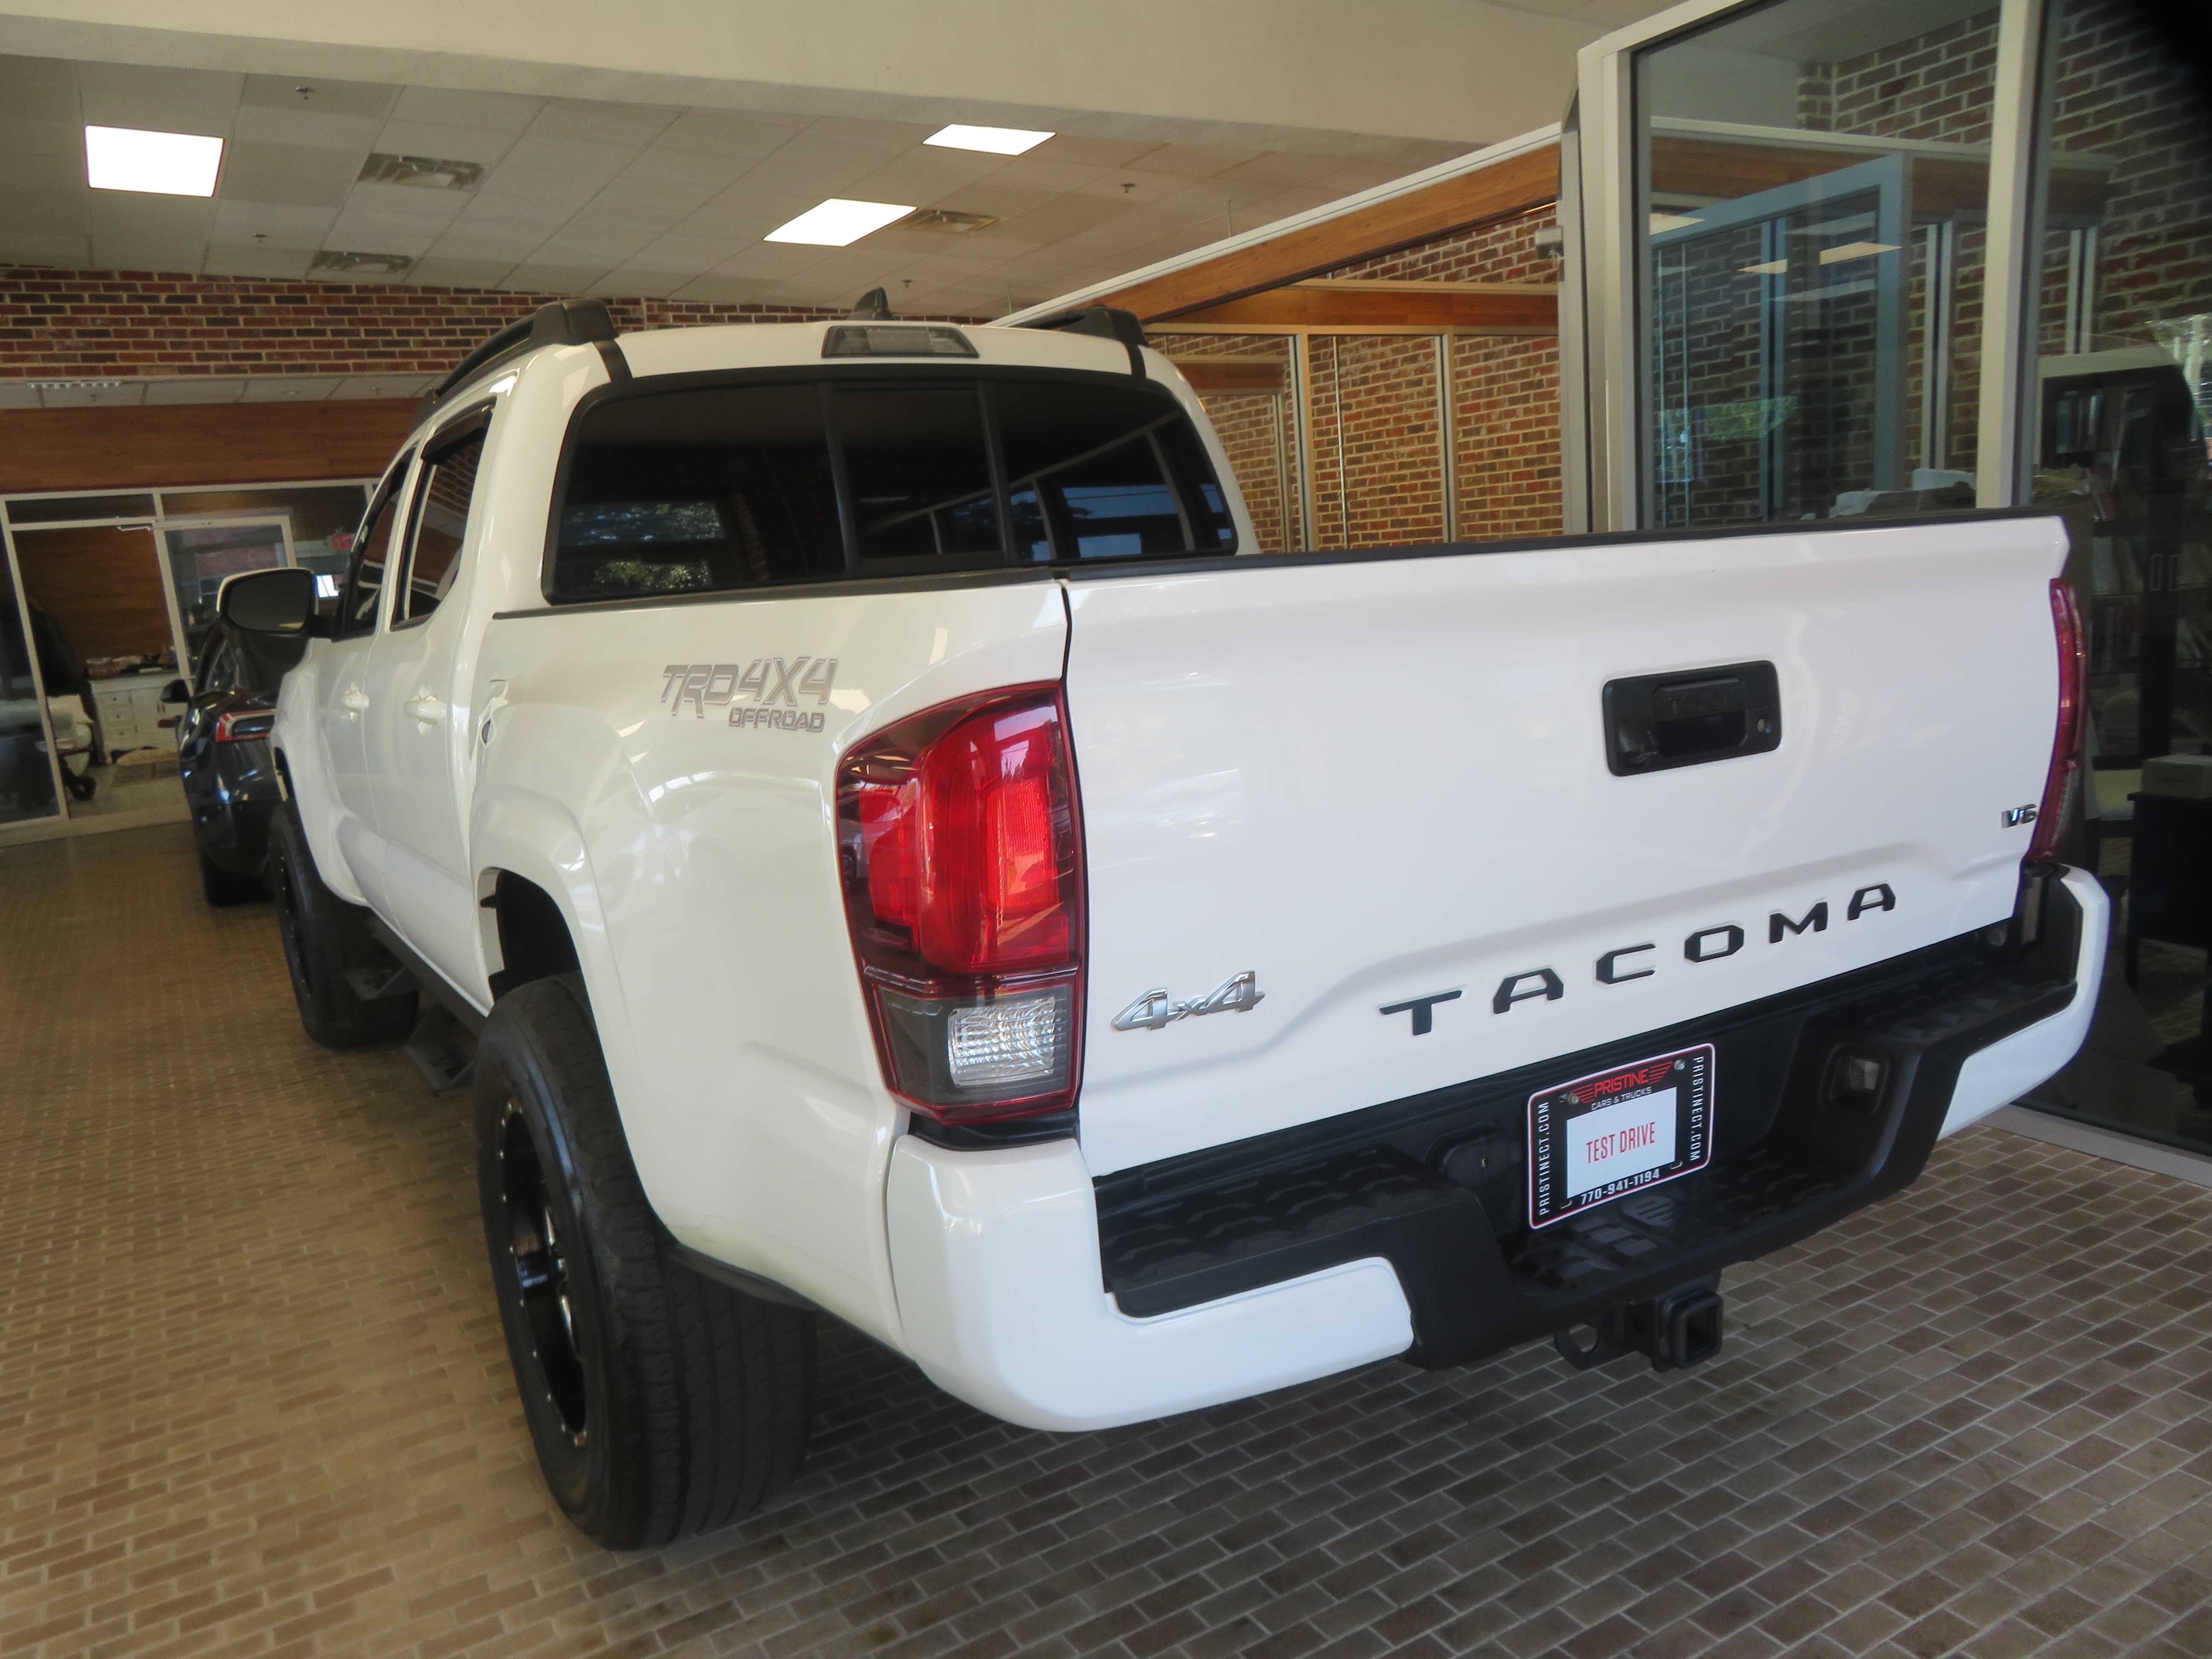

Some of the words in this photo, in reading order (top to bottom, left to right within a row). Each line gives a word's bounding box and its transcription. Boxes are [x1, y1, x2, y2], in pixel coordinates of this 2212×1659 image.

[728, 707, 826, 733] OFFROAD
[2000, 803, 2037, 829] V6
[1378, 883, 1896, 1036] TACOMA
[1591, 1098, 1612, 1111] CARS
[1613, 1095, 1620, 1103] &
[1621, 1086, 1652, 1102] TRUCKS
[1594, 1068, 1650, 1097] PRISTINE
[1689, 1056, 1704, 1161] PRISTINECT.COM
[1538, 1101, 1551, 1215] PRISTINECT.COM
[1586, 1134, 1615, 1164] TEST
[1620, 1121, 1656, 1153] DRIVE
[1581, 1168, 1660, 1205] 770-941-1194
